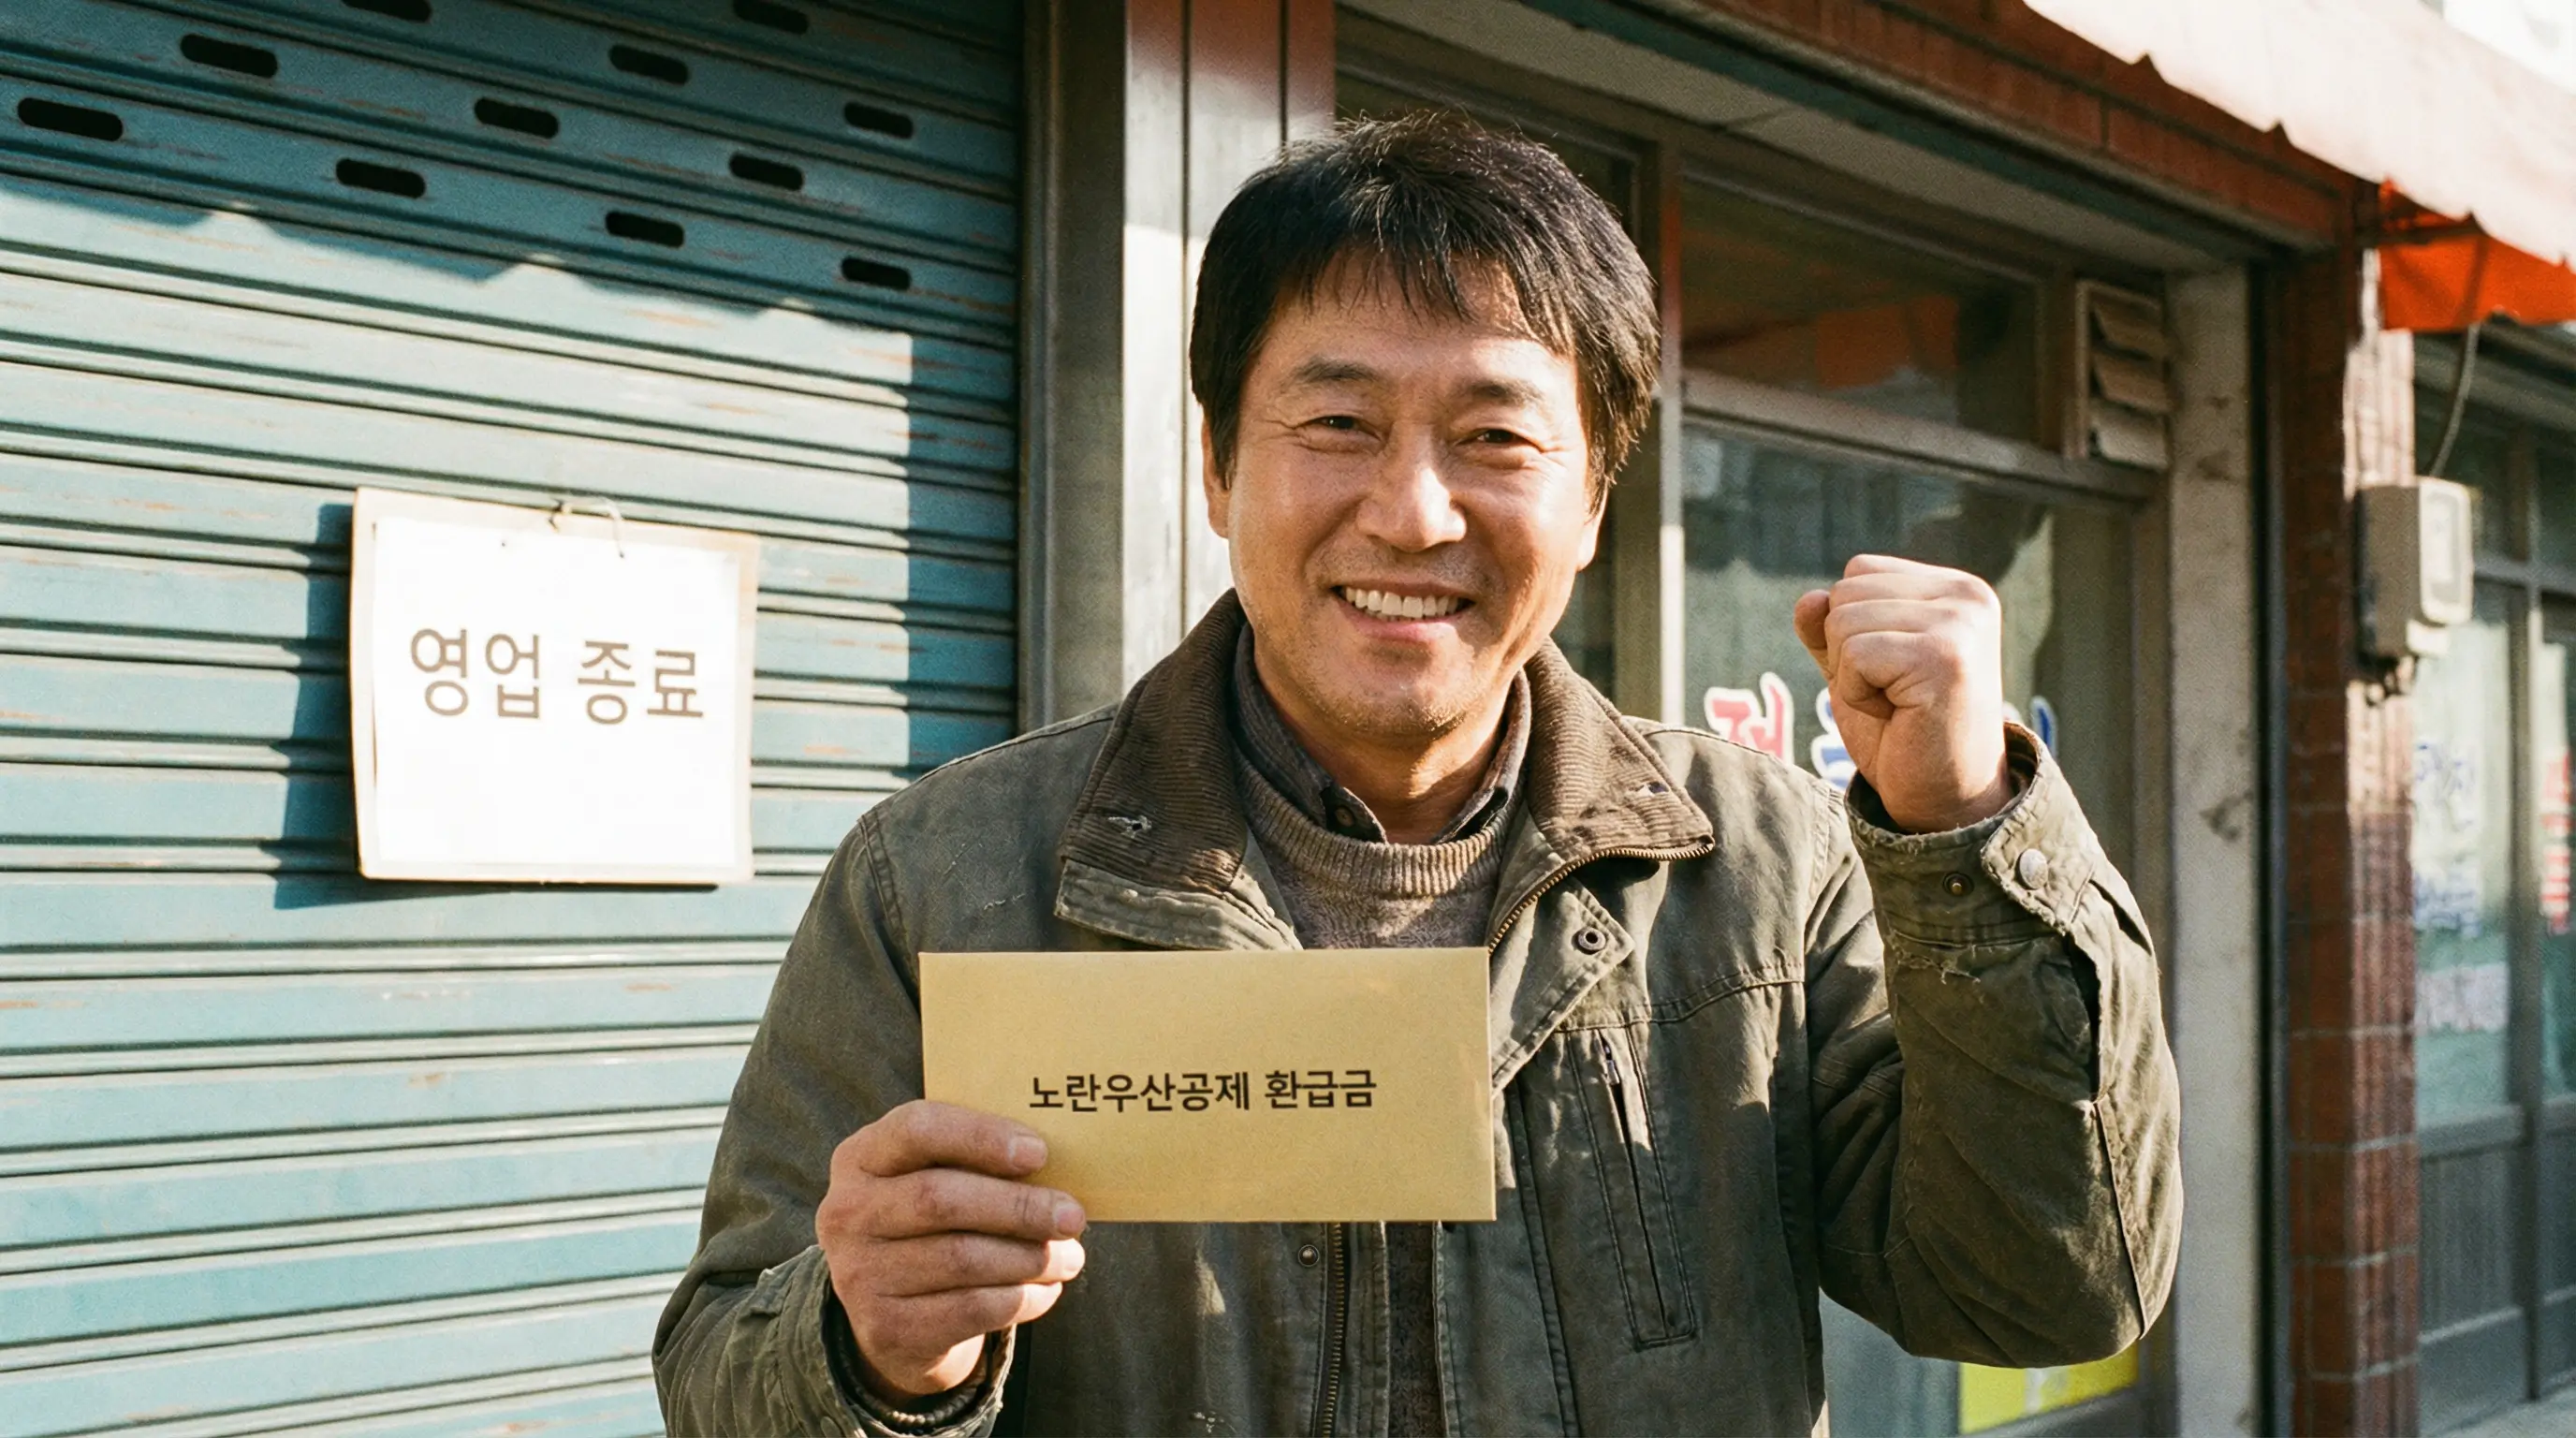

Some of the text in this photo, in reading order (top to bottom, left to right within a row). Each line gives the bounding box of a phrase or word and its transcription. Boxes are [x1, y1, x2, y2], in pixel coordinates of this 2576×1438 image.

[410, 628, 704, 726] 영업 종료
[1029, 1069, 1377, 1113] 노란우산공제 환급금
